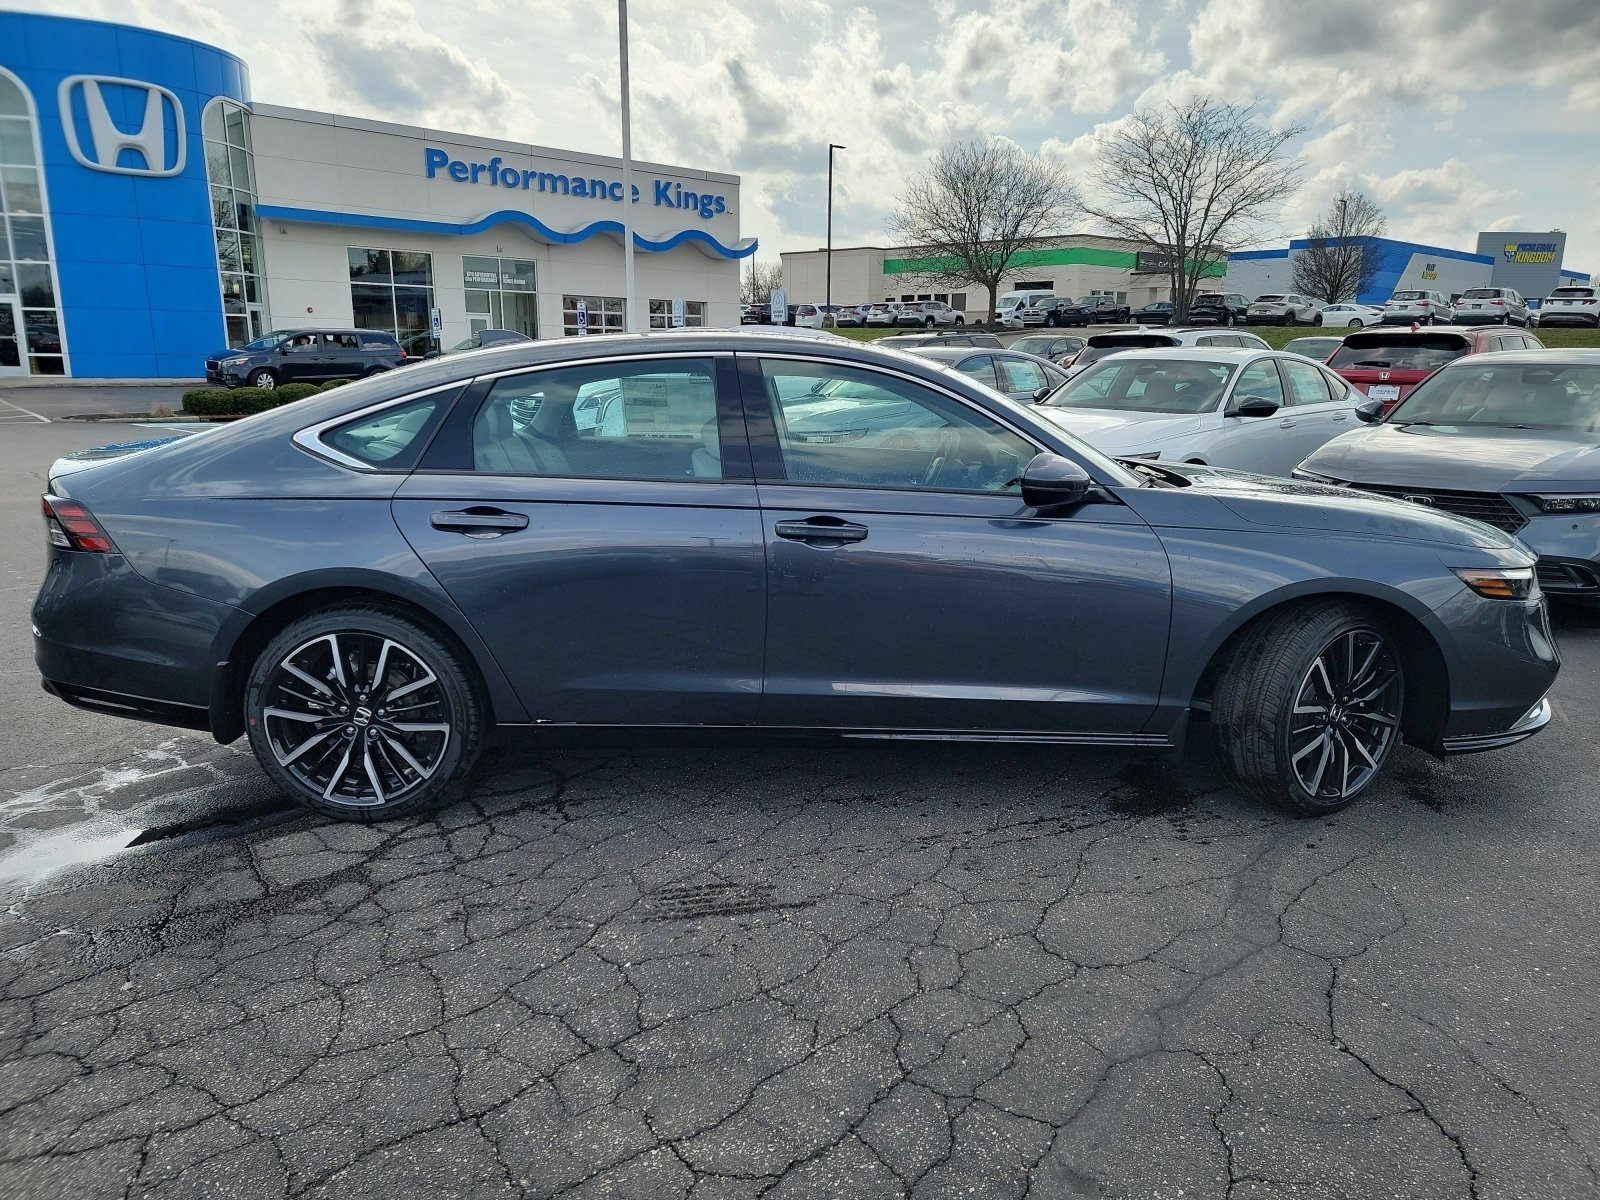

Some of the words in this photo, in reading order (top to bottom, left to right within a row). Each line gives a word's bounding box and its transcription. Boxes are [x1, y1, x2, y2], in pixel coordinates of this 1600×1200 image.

[425, 147, 639, 203] Performance
[654, 179, 726, 219] Kings
[1514, 251, 1556, 263] KINGDOM
